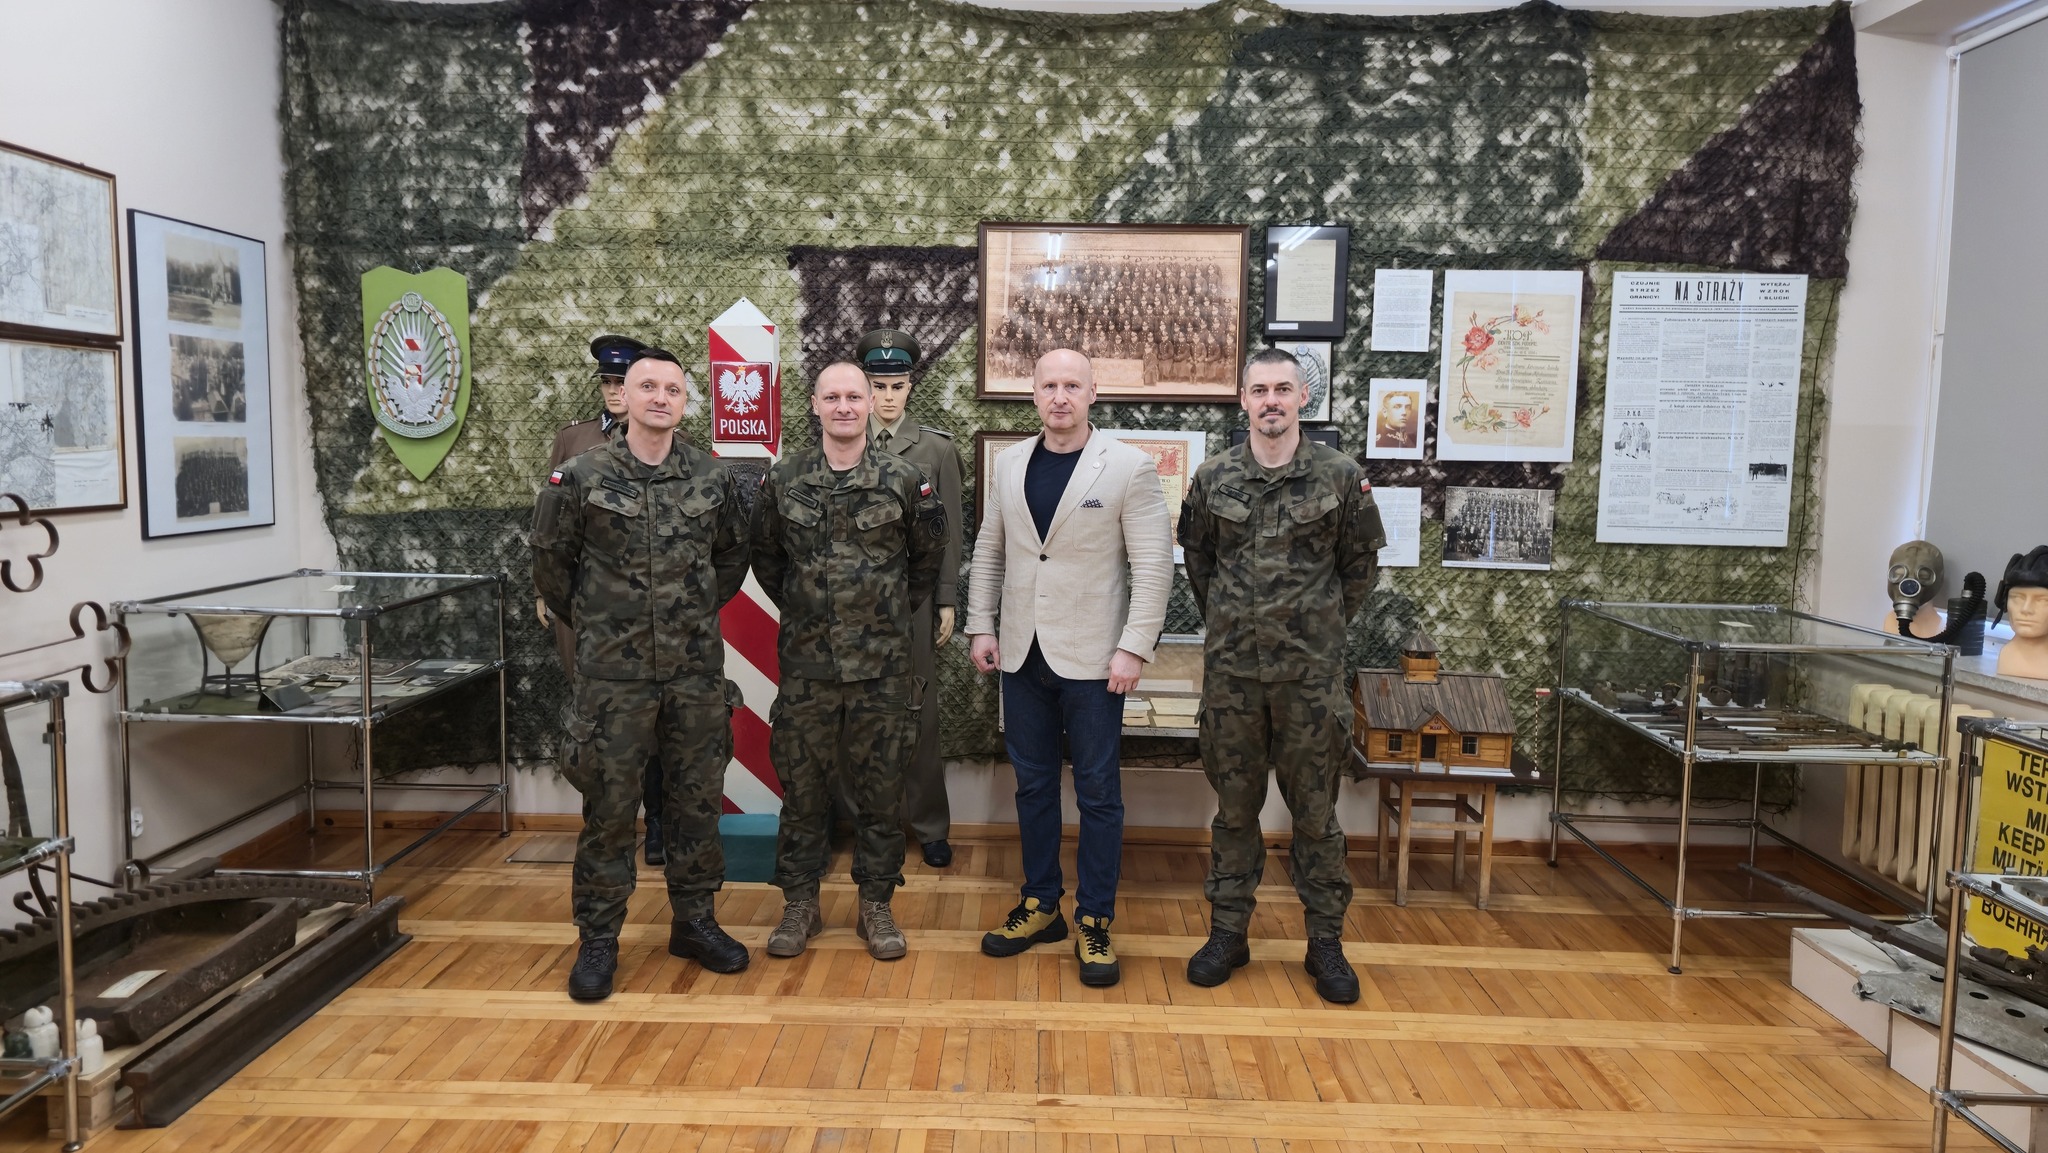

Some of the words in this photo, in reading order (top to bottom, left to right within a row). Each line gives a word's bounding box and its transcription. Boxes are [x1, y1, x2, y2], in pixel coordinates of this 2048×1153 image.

[1674, 280, 1689, 301] NA
[1696, 279, 1744, 301] STRAŻY
[720, 418, 767, 435] POLSKA
[2006, 769, 2048, 805] WST
[2025, 807, 2048, 836] MI
[1998, 821, 2046, 857] KEEP
[1992, 845, 2048, 876] MILITÄ
